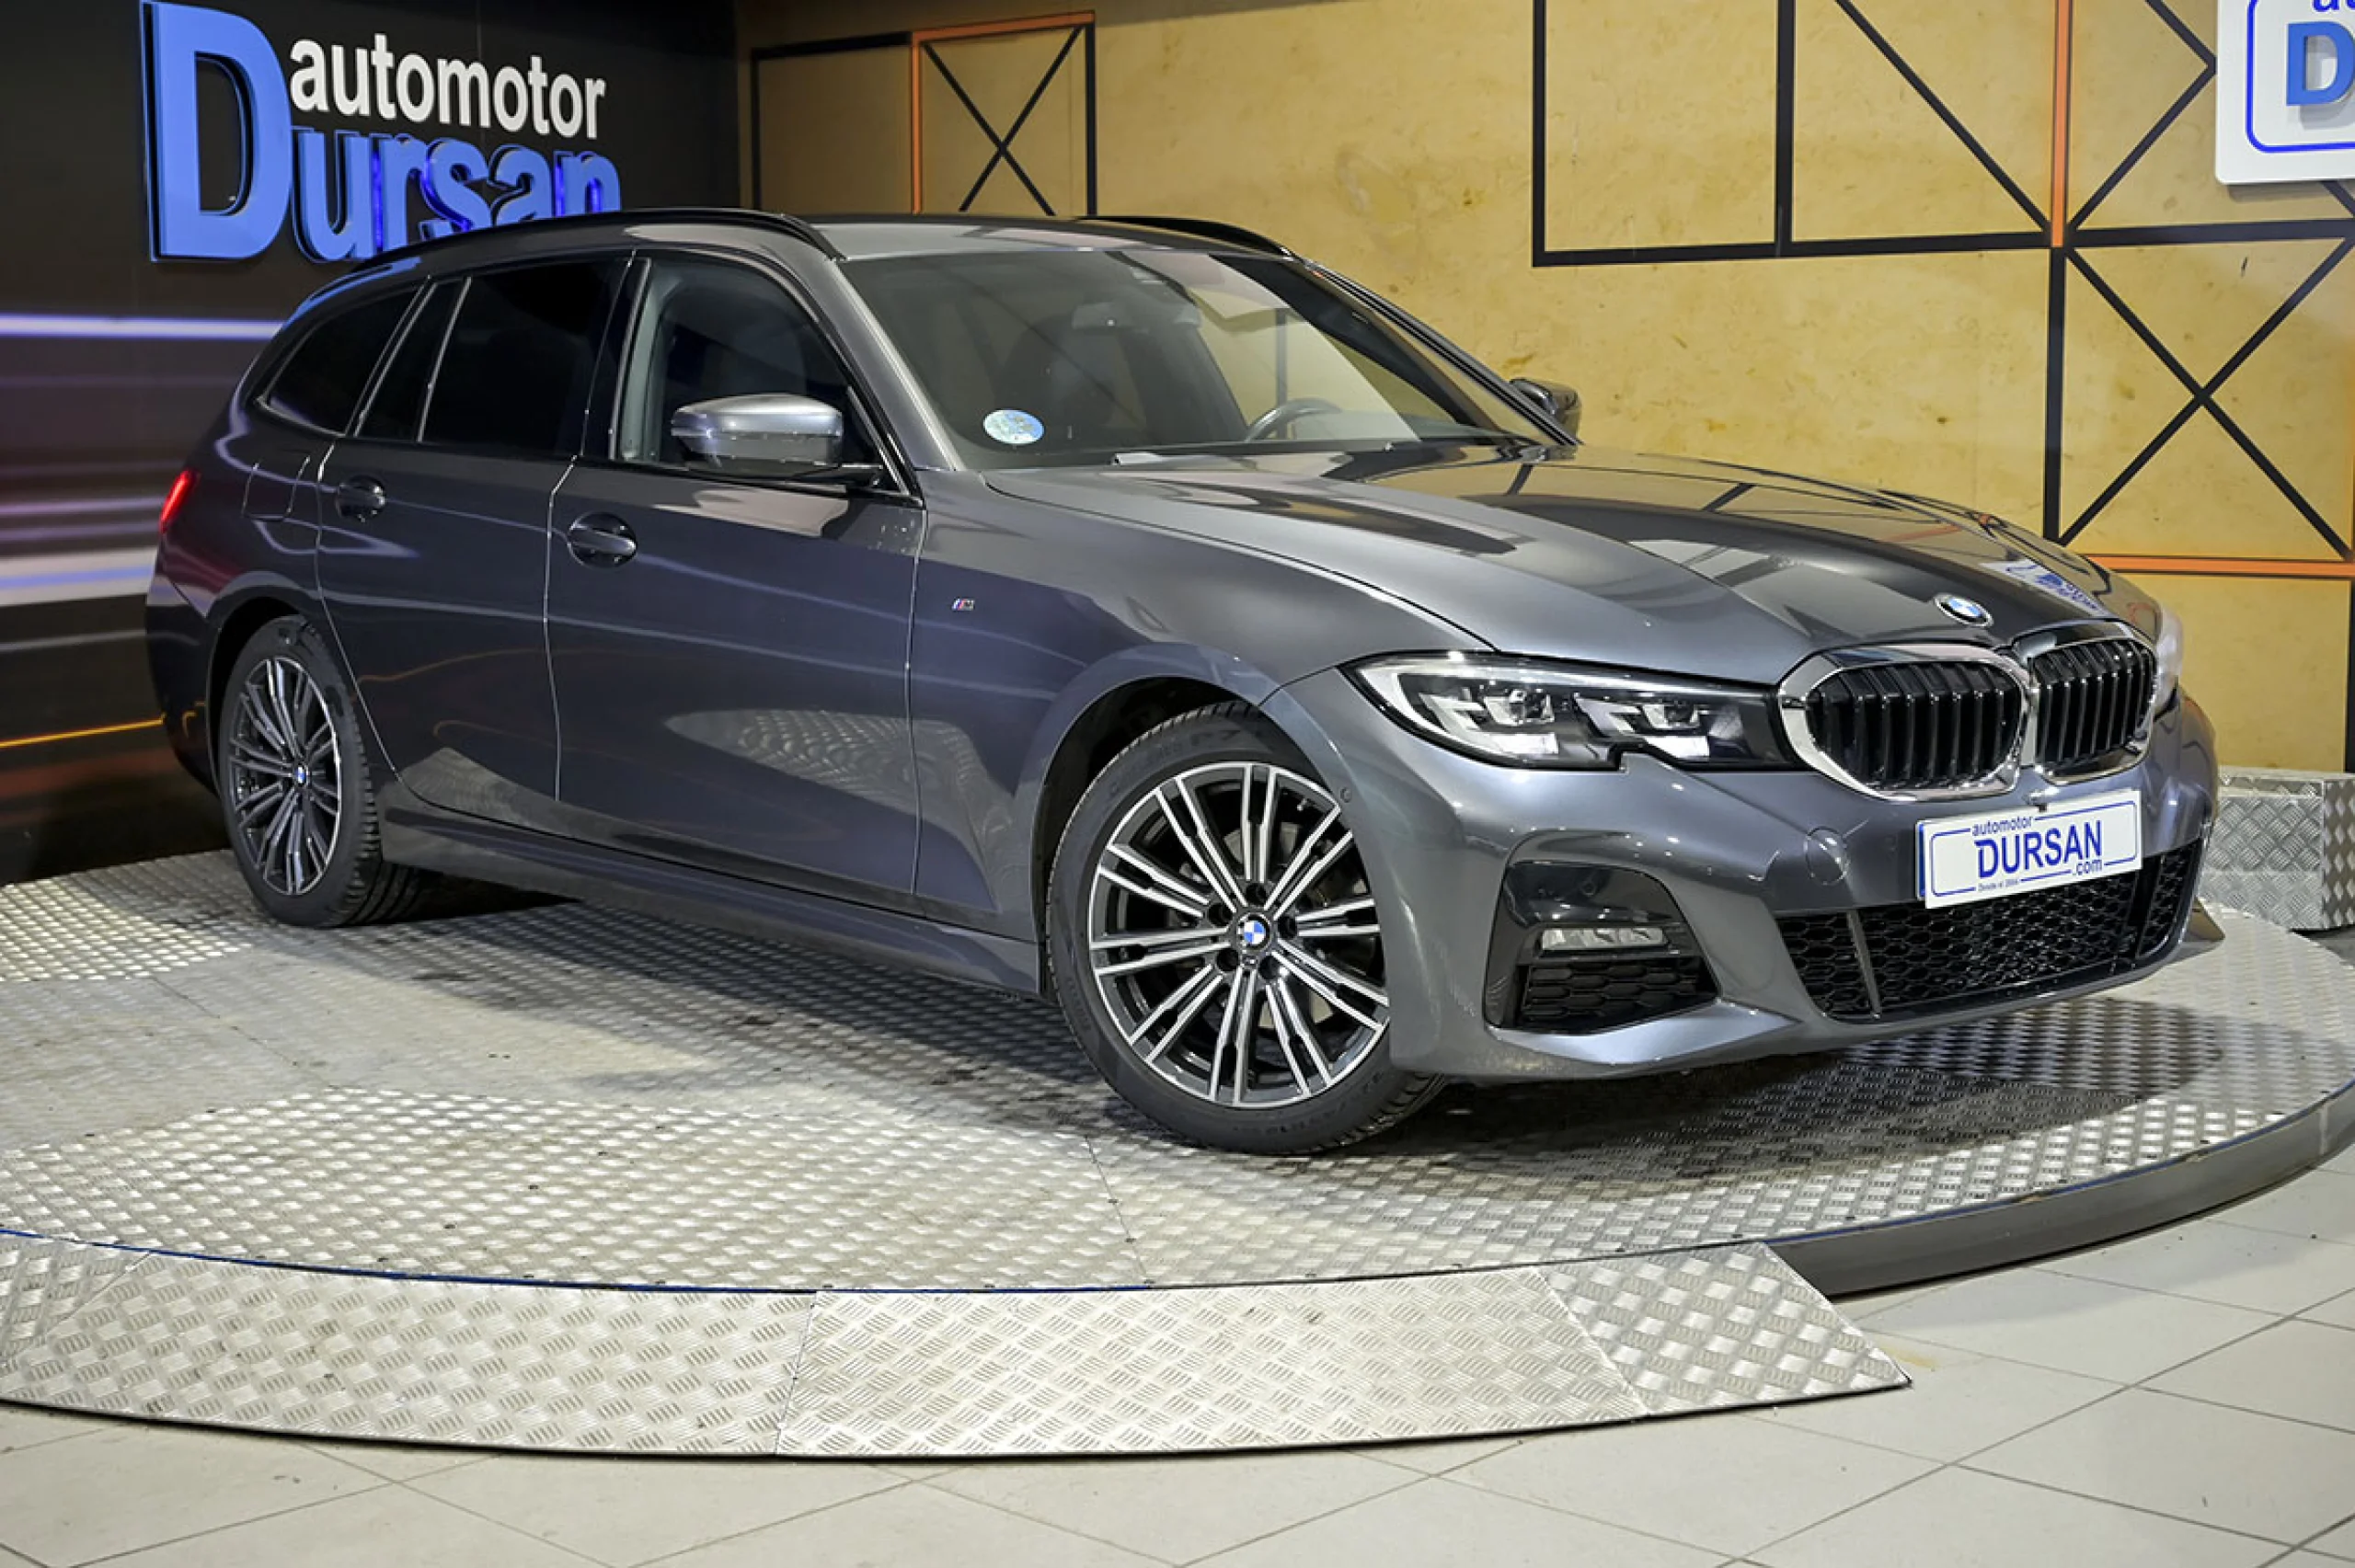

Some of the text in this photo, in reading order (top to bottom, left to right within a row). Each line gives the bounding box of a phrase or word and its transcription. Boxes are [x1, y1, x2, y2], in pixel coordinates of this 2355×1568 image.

[290, 33, 604, 138] automotor
[140, 0, 621, 262] Dursan
[1972, 817, 2031, 836] automotor
[1974, 820, 2102, 878] DURSAN
